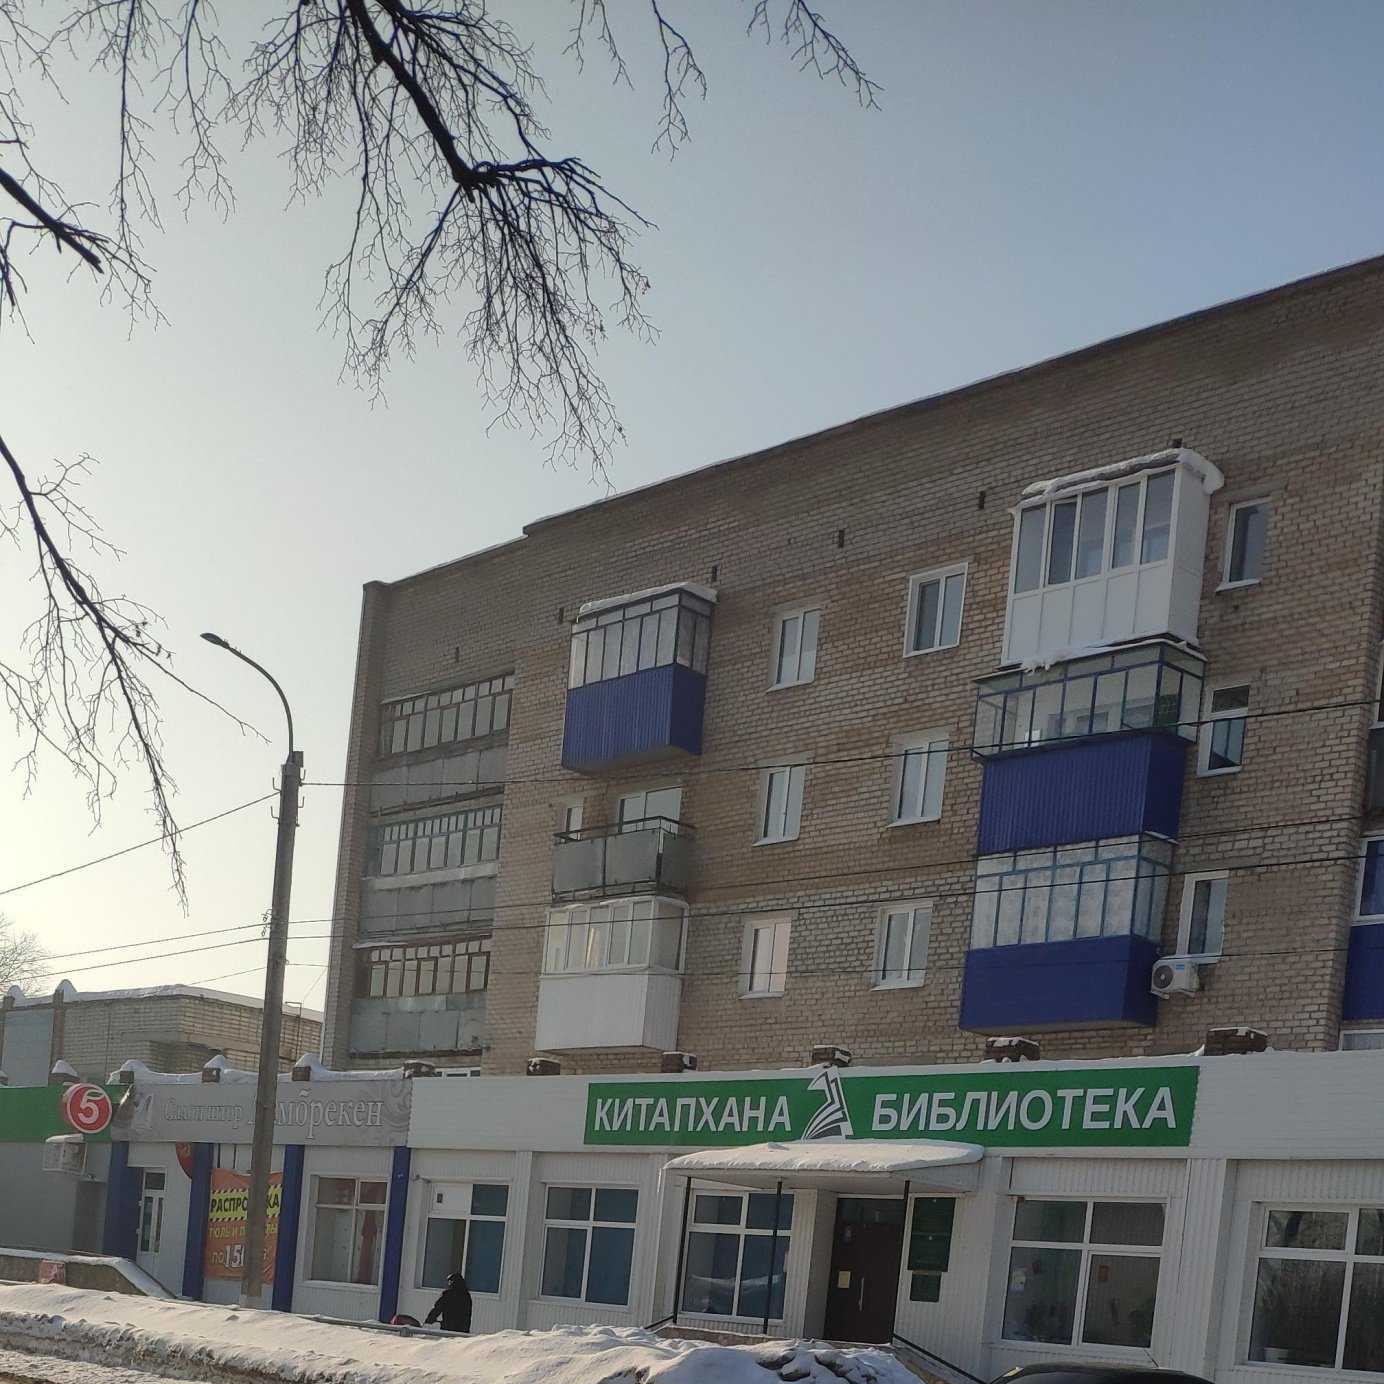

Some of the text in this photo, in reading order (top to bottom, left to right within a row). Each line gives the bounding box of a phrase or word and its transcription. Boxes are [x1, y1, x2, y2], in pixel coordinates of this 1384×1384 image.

[78, 1088, 104, 1124] 5
[593, 1096, 792, 1132] КИТАПХАНА
[871, 1087, 1177, 1131] БИБЛИОТЕКА
